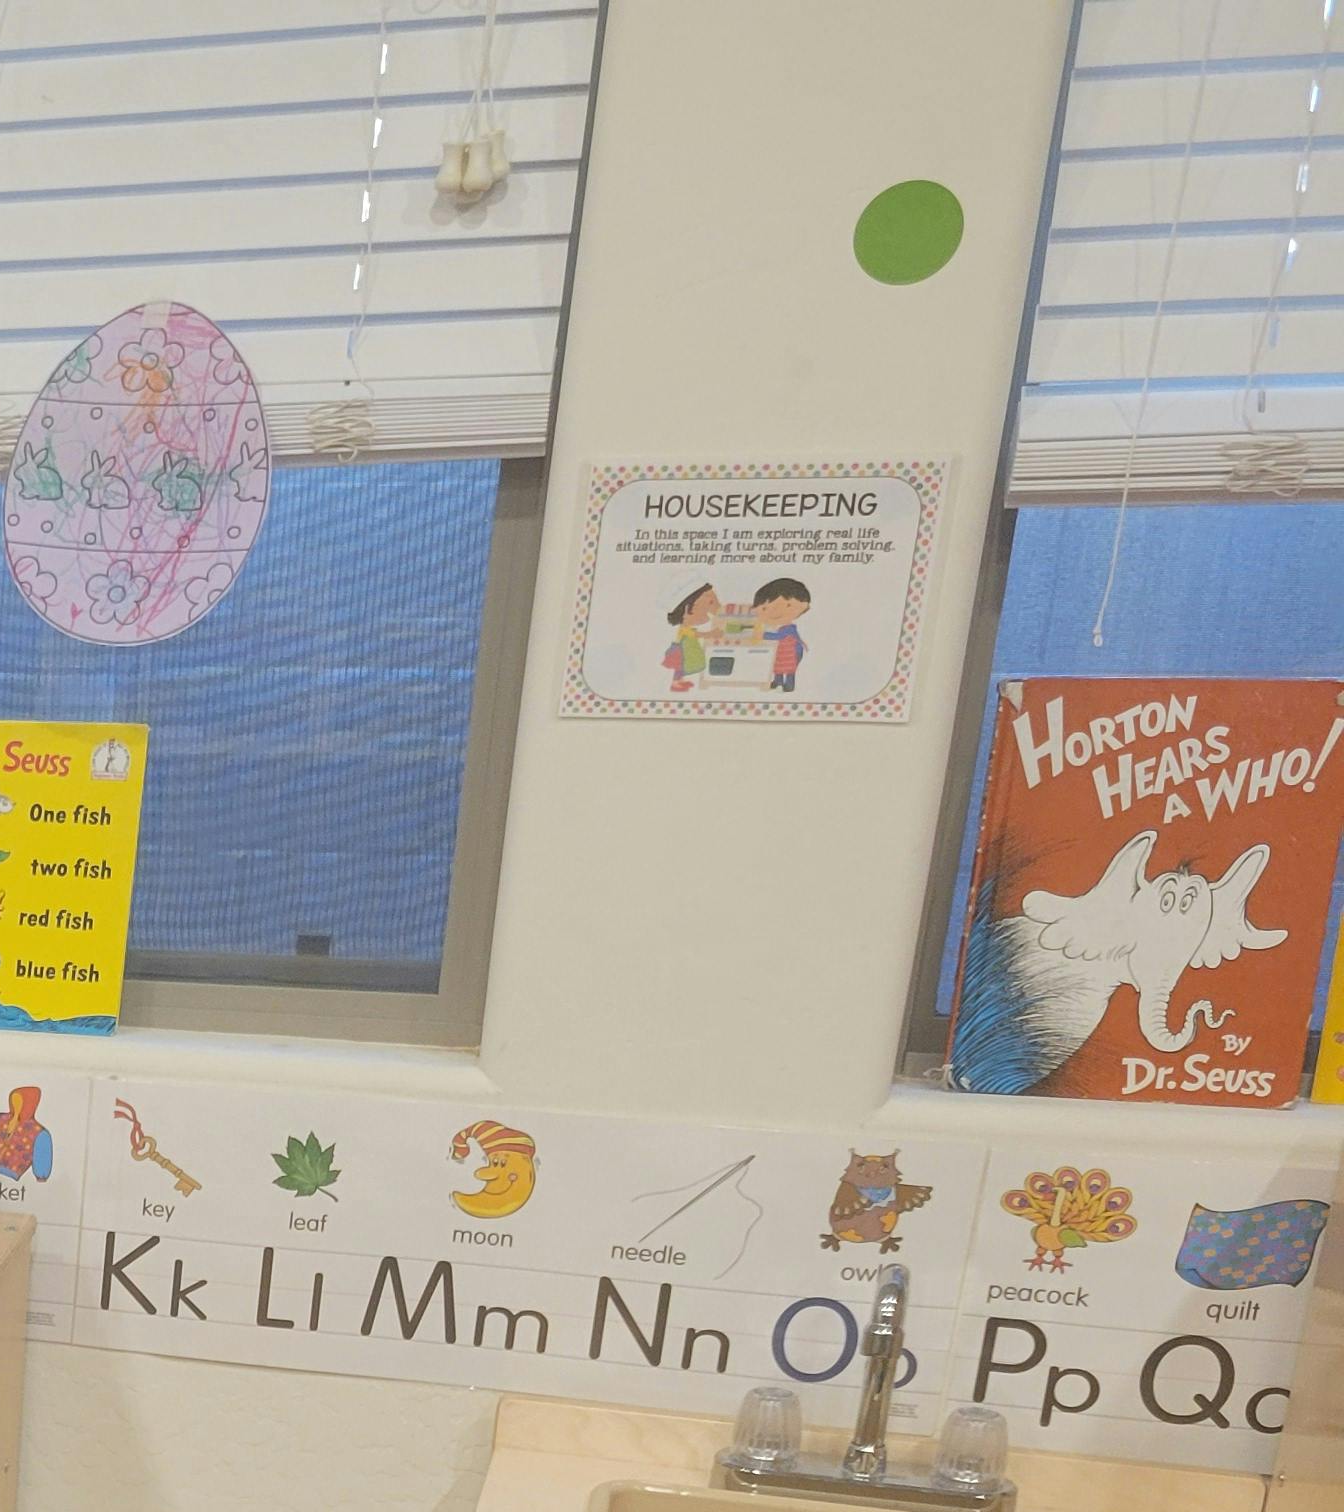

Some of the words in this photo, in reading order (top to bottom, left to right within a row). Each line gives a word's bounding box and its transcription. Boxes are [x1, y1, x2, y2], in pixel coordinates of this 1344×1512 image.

[644, 492, 878, 519] HOUSEKEEPING
[635, 529, 650, 540] In
[654, 529, 679, 540] this
[682, 530, 717, 542] space
[722, 529, 728, 540] I
[733, 531, 753, 540] am
[757, 529, 822, 543] exploring
[826, 529, 852, 539] real
[858, 528, 880, 539] life
[689, 540, 731, 553] taking
[782, 540, 837, 552] problem
[633, 553, 655, 563] and
[660, 552, 716, 565] learning
[720, 554, 755, 563] more
[760, 553, 796, 563] about
[803, 554, 823, 565] my
[1012, 694, 1198, 789] HORTON
[3, 741, 71, 777] Seuss
[1092, 726, 1230, 819] HEARS
[1163, 794, 1192, 824] A
[1195, 718, 1344, 822] WHO!
[30, 803, 66, 823] One
[73, 805, 111, 825] fish
[31, 859, 68, 877] two
[74, 859, 112, 880] fish
[19, 910, 49, 927] red
[56, 910, 94, 931] fish
[16, 960, 56, 979] blue
[62, 963, 100, 982] fish
[1221, 1034, 1252, 1056] By
[1122, 1057, 1176, 1095] Dr.
[1180, 1054, 1276, 1097] Seuss
[142, 1198, 175, 1222] key
[289, 1212, 328, 1233] leaf
[452, 1229, 514, 1248] moon
[611, 1245, 687, 1266] needle
[840, 1264, 883, 1282] owl
[986, 1284, 1090, 1307] peacock
[1206, 1301, 1261, 1323] quilt
[101, 1231, 207, 1320] Kk
[360, 1256, 549, 1354] Mm
[589, 1275, 730, 1373] Nn
[973, 1317, 1100, 1427] Pp
